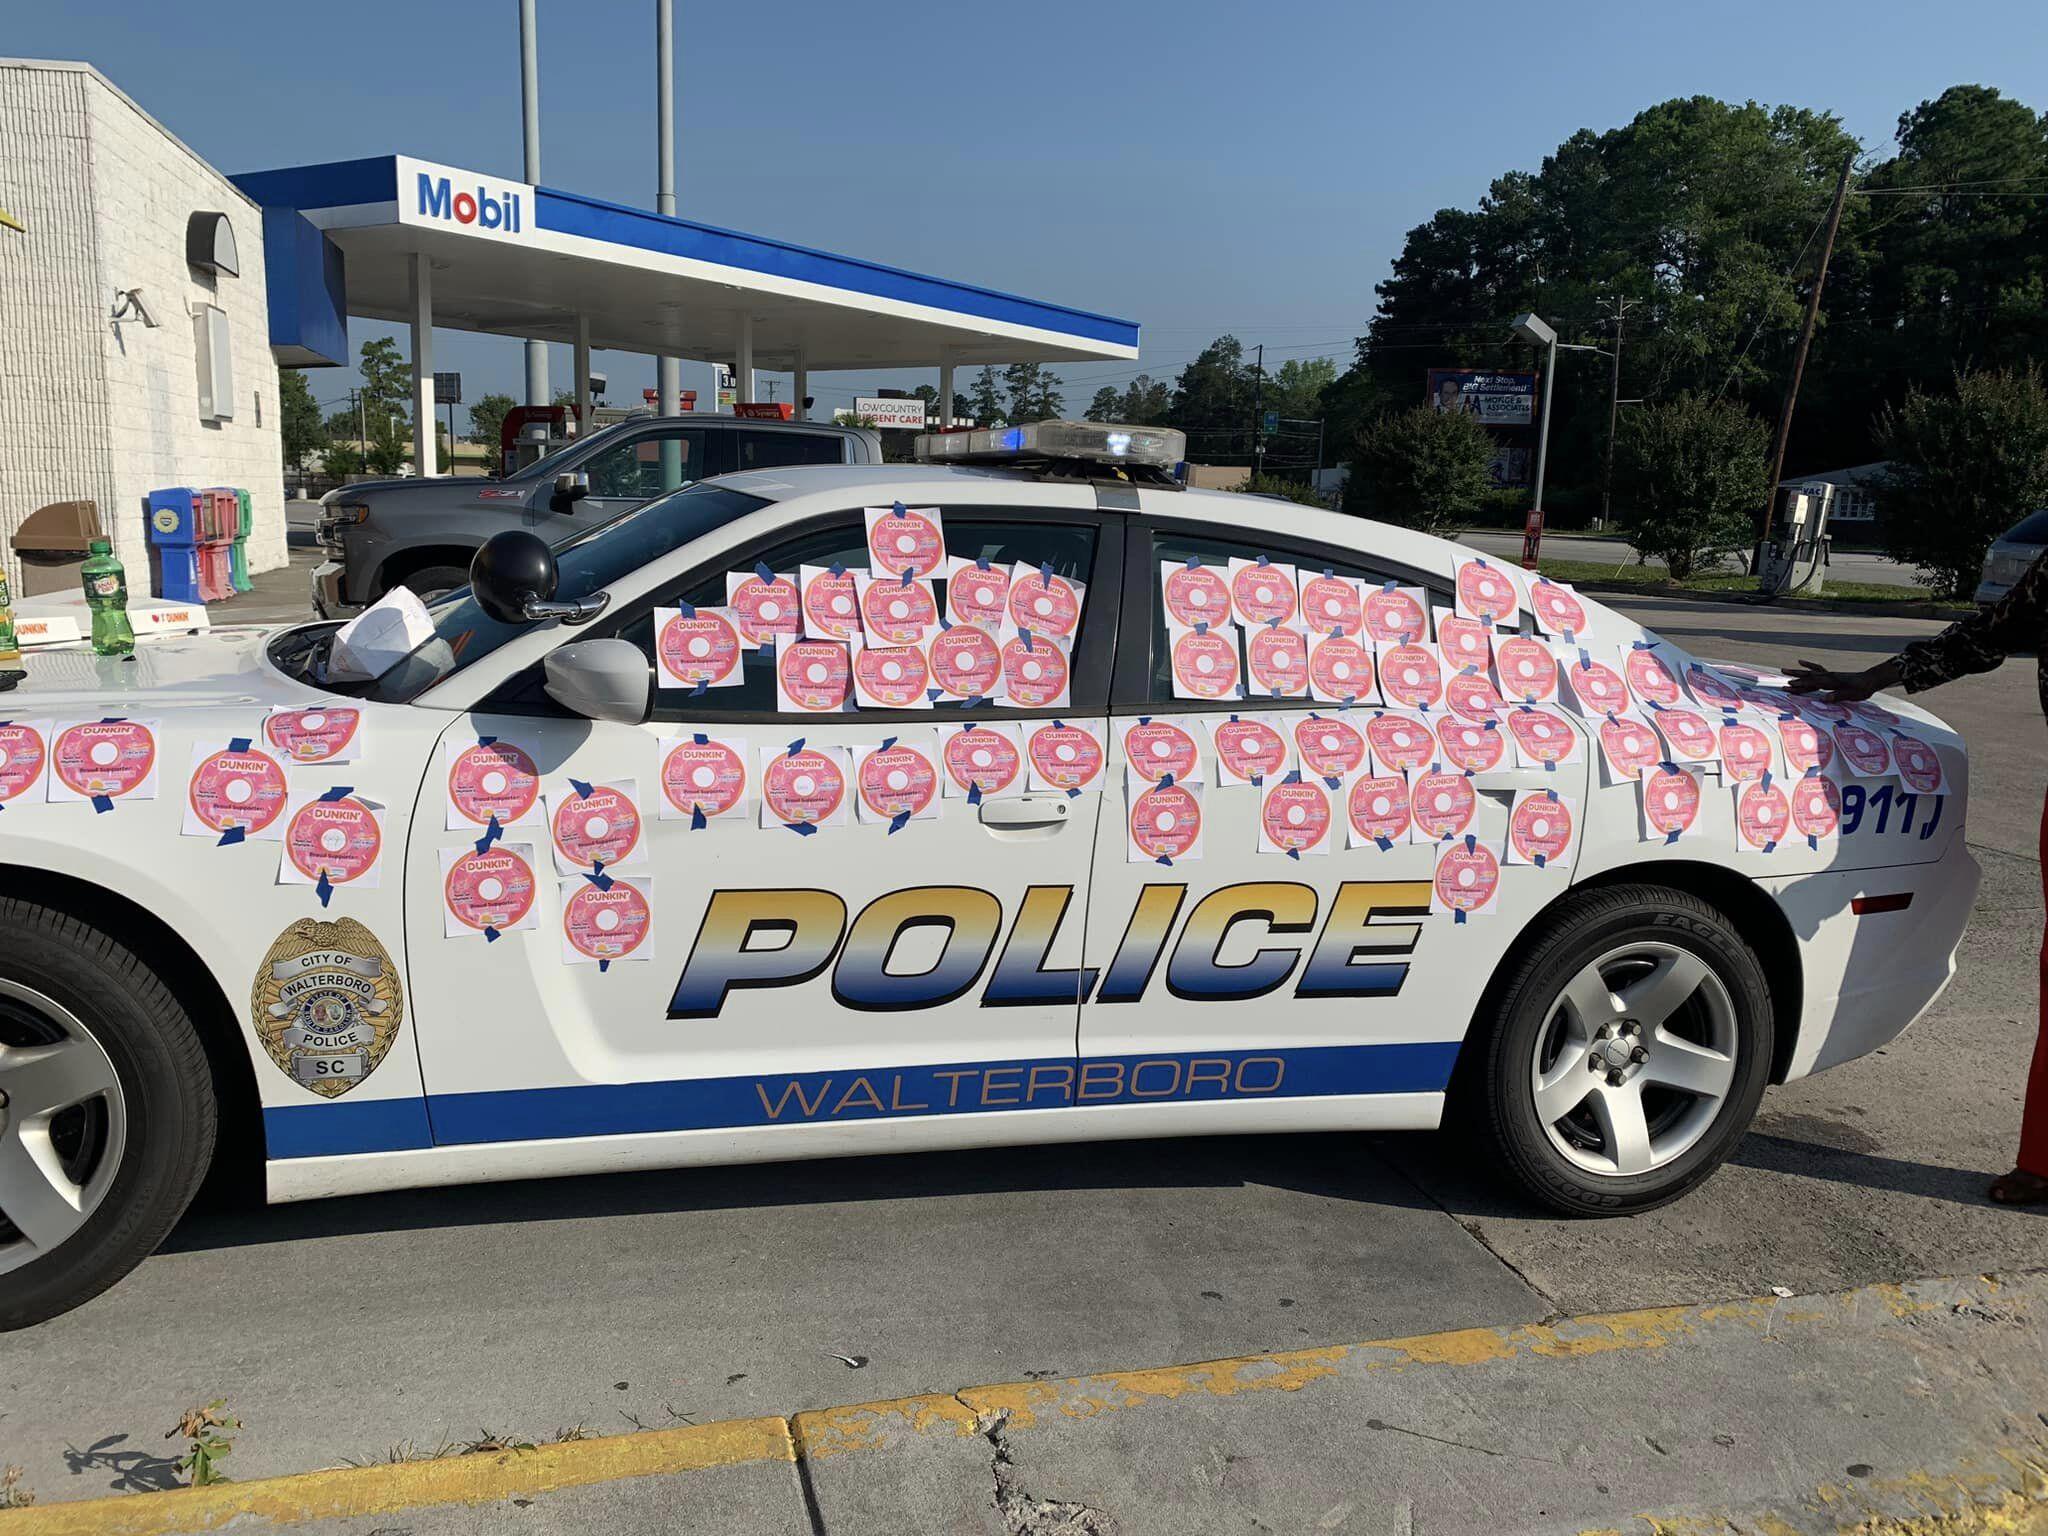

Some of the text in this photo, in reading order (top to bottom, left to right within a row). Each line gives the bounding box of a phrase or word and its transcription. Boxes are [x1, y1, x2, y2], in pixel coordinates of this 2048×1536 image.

[417, 173, 520, 233] Mobil
[857, 403, 922, 414] LOWCOUNTRY
[899, 415, 923, 424] CARE
[887, 521, 922, 529] DUNKIN'
[969, 572, 1003, 583] DUNKIN'
[1181, 575, 1212, 584] DUNKIN'
[822, 580, 854, 589] DUNKI
[750, 586, 787, 594] DUNKIN'
[166, 611, 189, 622] DUNKIN'
[679, 621, 718, 630] DUNKIN'
[946, 635, 981, 645] DUNKIN'
[1189, 640, 1221, 648] DUNKIN'
[799, 648, 837, 656] DUNKIN'
[83, 727, 133, 735] DUNKIN'
[473, 753, 517, 764] DUNKIN'
[684, 750, 724, 759] DUNKIN'
[785, 759, 824, 769] DUNKIN'
[876, 755, 913, 765] DUNKIN'
[219, 760, 267, 771] DUNKIN'
[1365, 782, 1397, 790] DUNKIN'
[1426, 778, 1458, 787] DUNKIN'
[1282, 789, 1315, 798] DUNKIN'
[573, 797, 615, 811] DUNKIN'
[1149, 795, 1183, 804] DUNKIN'
[1528, 804, 1559, 812] DUNKIN'
[314, 809, 360, 820] DUNKIN'
[468, 858, 512, 871] DUNKIN'
[587, 891, 629, 902] DUNKIN'
[665, 881, 1435, 1019] POLICE
[301, 954, 352, 967] CITY OF
[284, 974, 371, 997] WALTERBORO
[302, 1031, 358, 1047] POLICE
[316, 1060, 345, 1075] SC
[756, 1055, 1287, 1120] WALTERBORO
